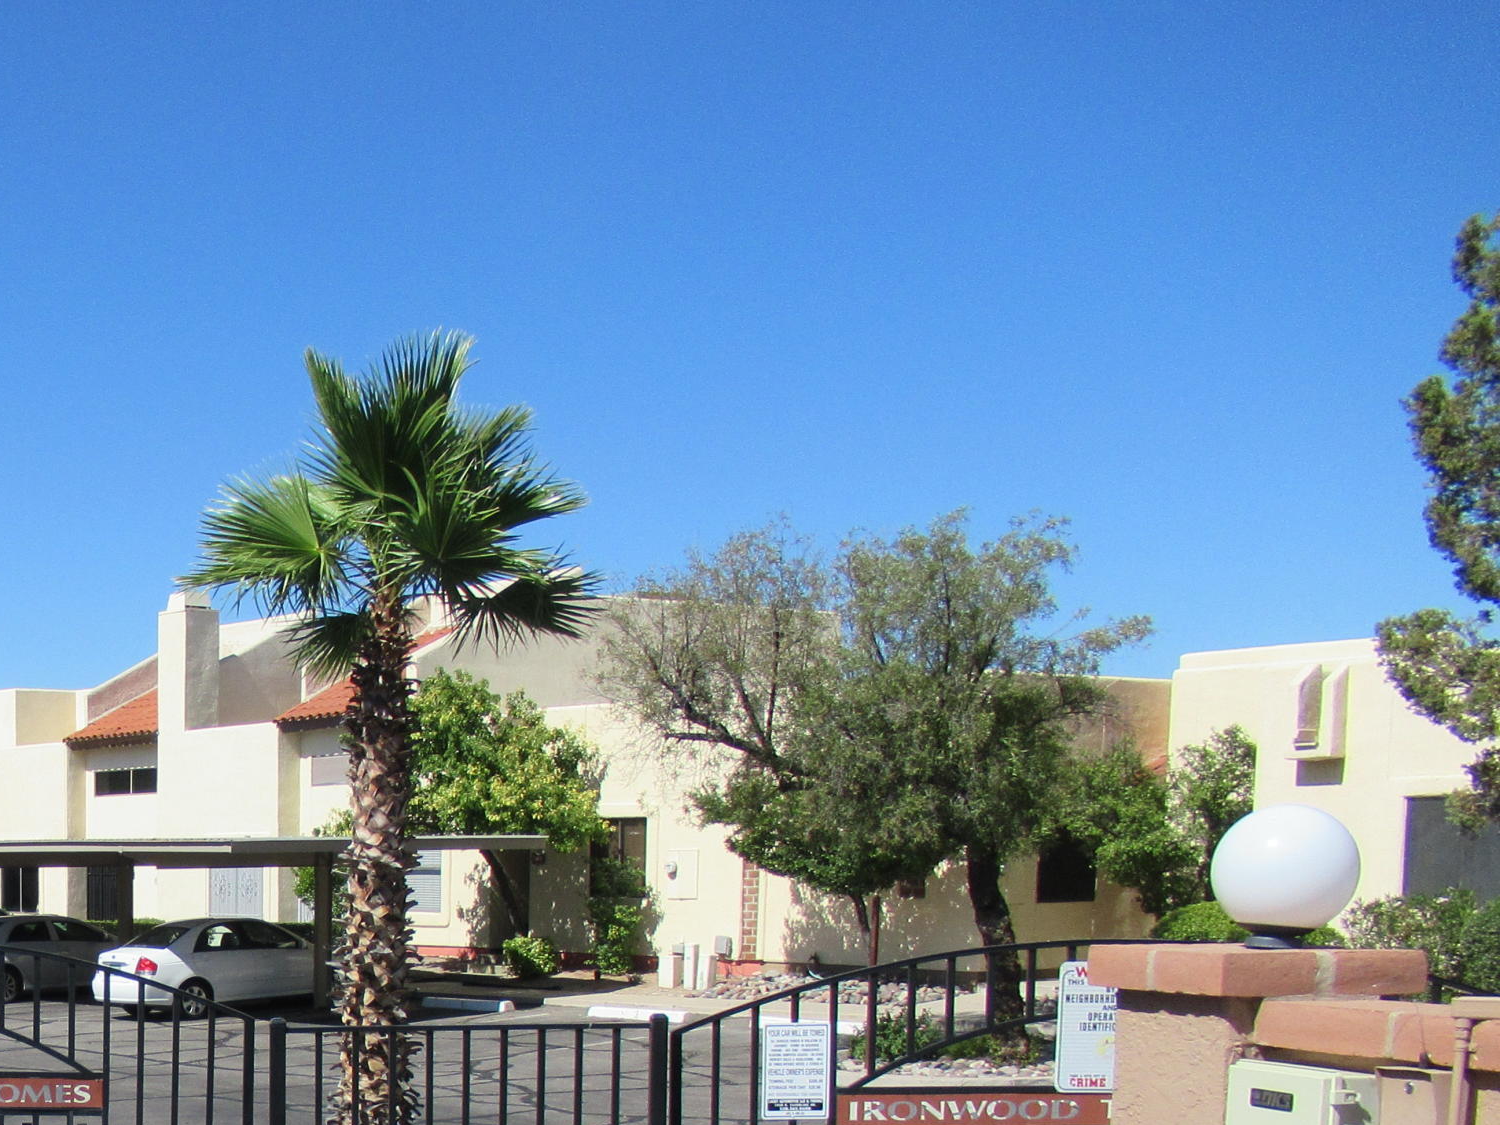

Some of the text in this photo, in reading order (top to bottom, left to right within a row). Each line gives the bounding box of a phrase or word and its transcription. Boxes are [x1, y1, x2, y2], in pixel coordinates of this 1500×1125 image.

[1065, 994, 1116, 1003] NEIGHBORHO
[1069, 1078, 1106, 1087] CRIME
[848, 1100, 1080, 1121] IRONWOOD
